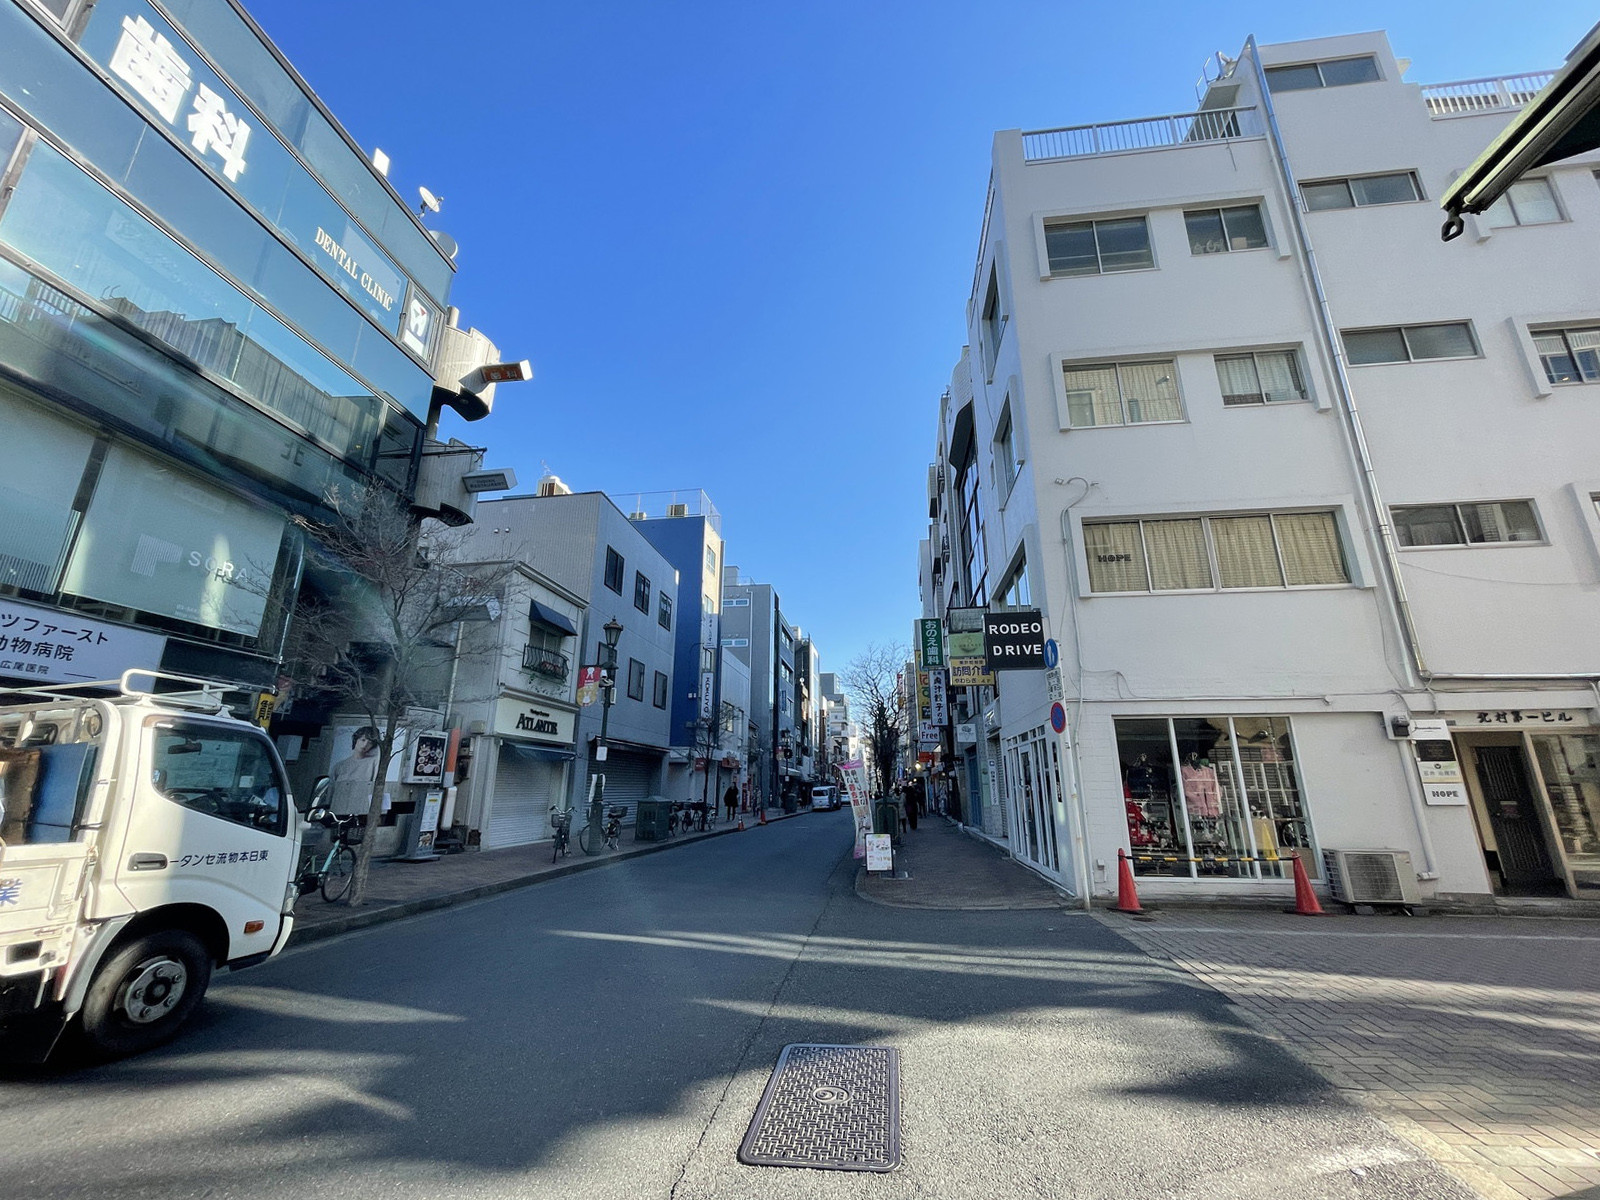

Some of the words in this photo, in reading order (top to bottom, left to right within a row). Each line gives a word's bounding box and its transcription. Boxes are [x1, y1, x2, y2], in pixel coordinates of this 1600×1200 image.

[109, 14, 251, 183] 歯科
[314, 226, 358, 280] DENTAL
[361, 272, 393, 311] CLINIC
[1097, 554, 1132, 563] HOPE
[988, 622, 1041, 635] RODEO
[925, 620, 939, 665] おのえ歯科
[992, 644, 1043, 656] DRIVE
[1476, 711, 1573, 724] 北村第一ビル
[921, 731, 938, 740] Free
[1431, 790, 1459, 798] HOPE
